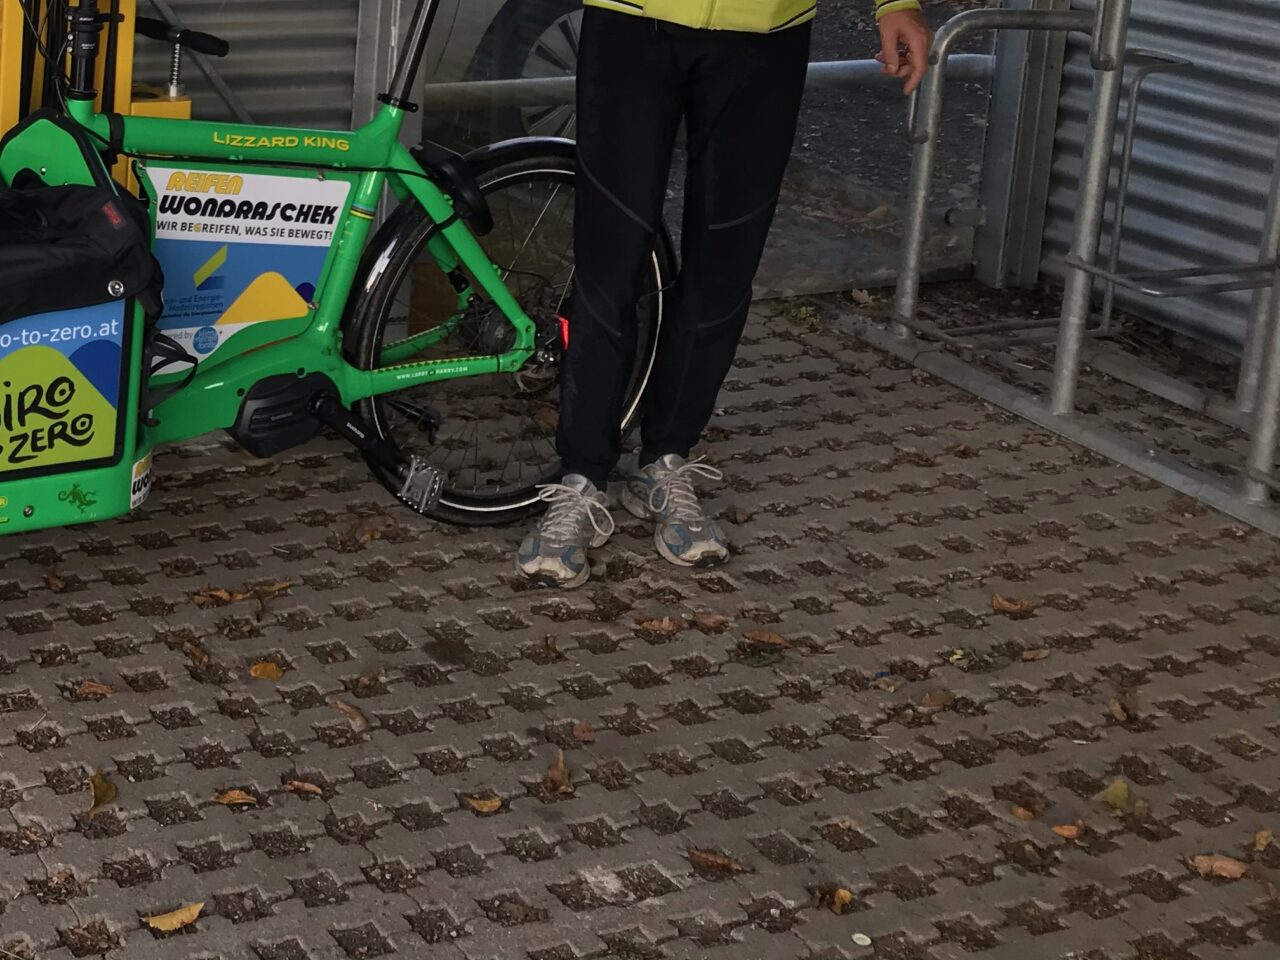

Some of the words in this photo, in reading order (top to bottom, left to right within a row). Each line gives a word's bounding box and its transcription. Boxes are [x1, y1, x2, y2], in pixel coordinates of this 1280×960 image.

[213, 131, 299, 148] LIZZARD
[304, 136, 350, 151] KING
[166, 171, 244, 195] REIFEN
[158, 194, 339, 225] WONDRASCHEK
[157, 220, 177, 231] WIR
[180, 222, 242, 237] BEGREIFEN,
[244, 226, 268, 236] WAS
[270, 228, 285, 238] SIE
[288, 228, 333, 240] BEWEGT!
[7, 413, 94, 464] ZERO
